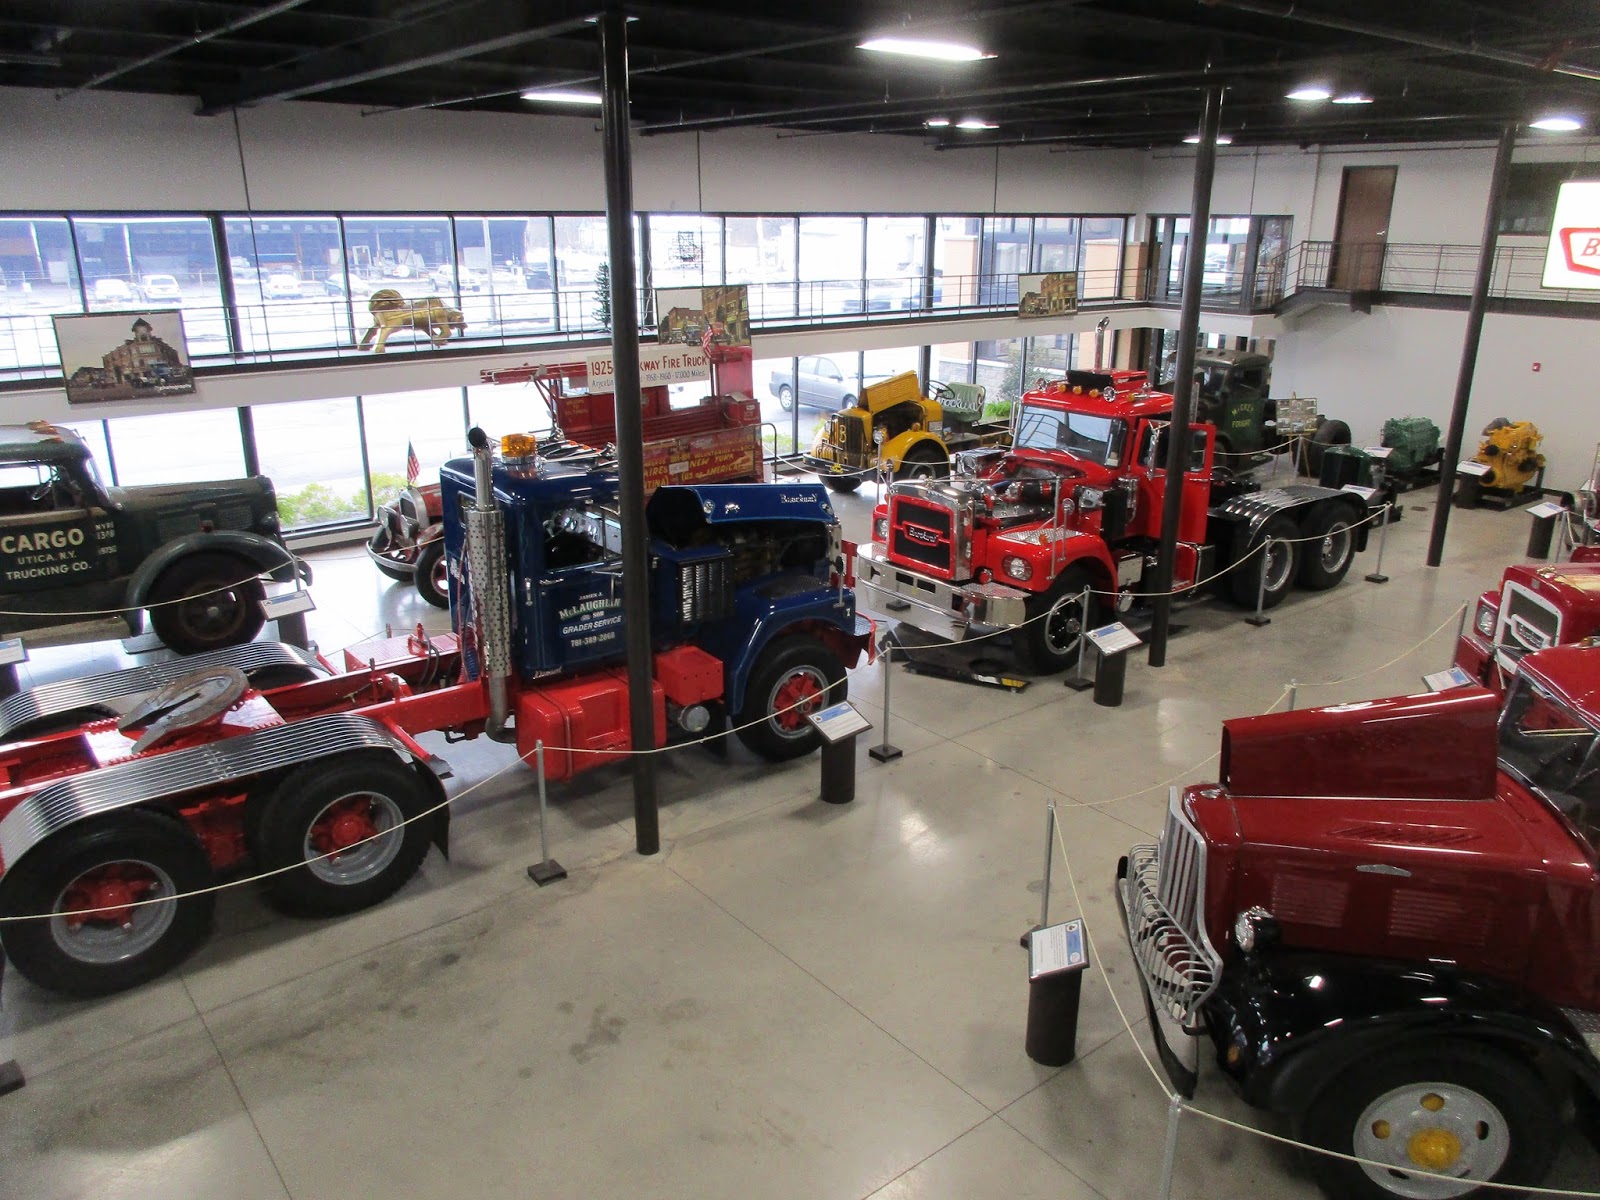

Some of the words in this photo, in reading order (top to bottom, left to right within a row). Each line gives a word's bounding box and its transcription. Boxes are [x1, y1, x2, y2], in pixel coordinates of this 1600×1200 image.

[591, 360, 614, 376] 1925
[662, 355, 681, 369] FIRE
[682, 353, 708, 368] TRUCK
[690, 457, 710, 468] NEW
[1, 528, 85, 554] CARGO
[6, 564, 69, 581] TRUCKING
[72, 561, 92, 571] CO.
[562, 621, 593, 635] GRADER
[593, 615, 622, 629] SERVICE
